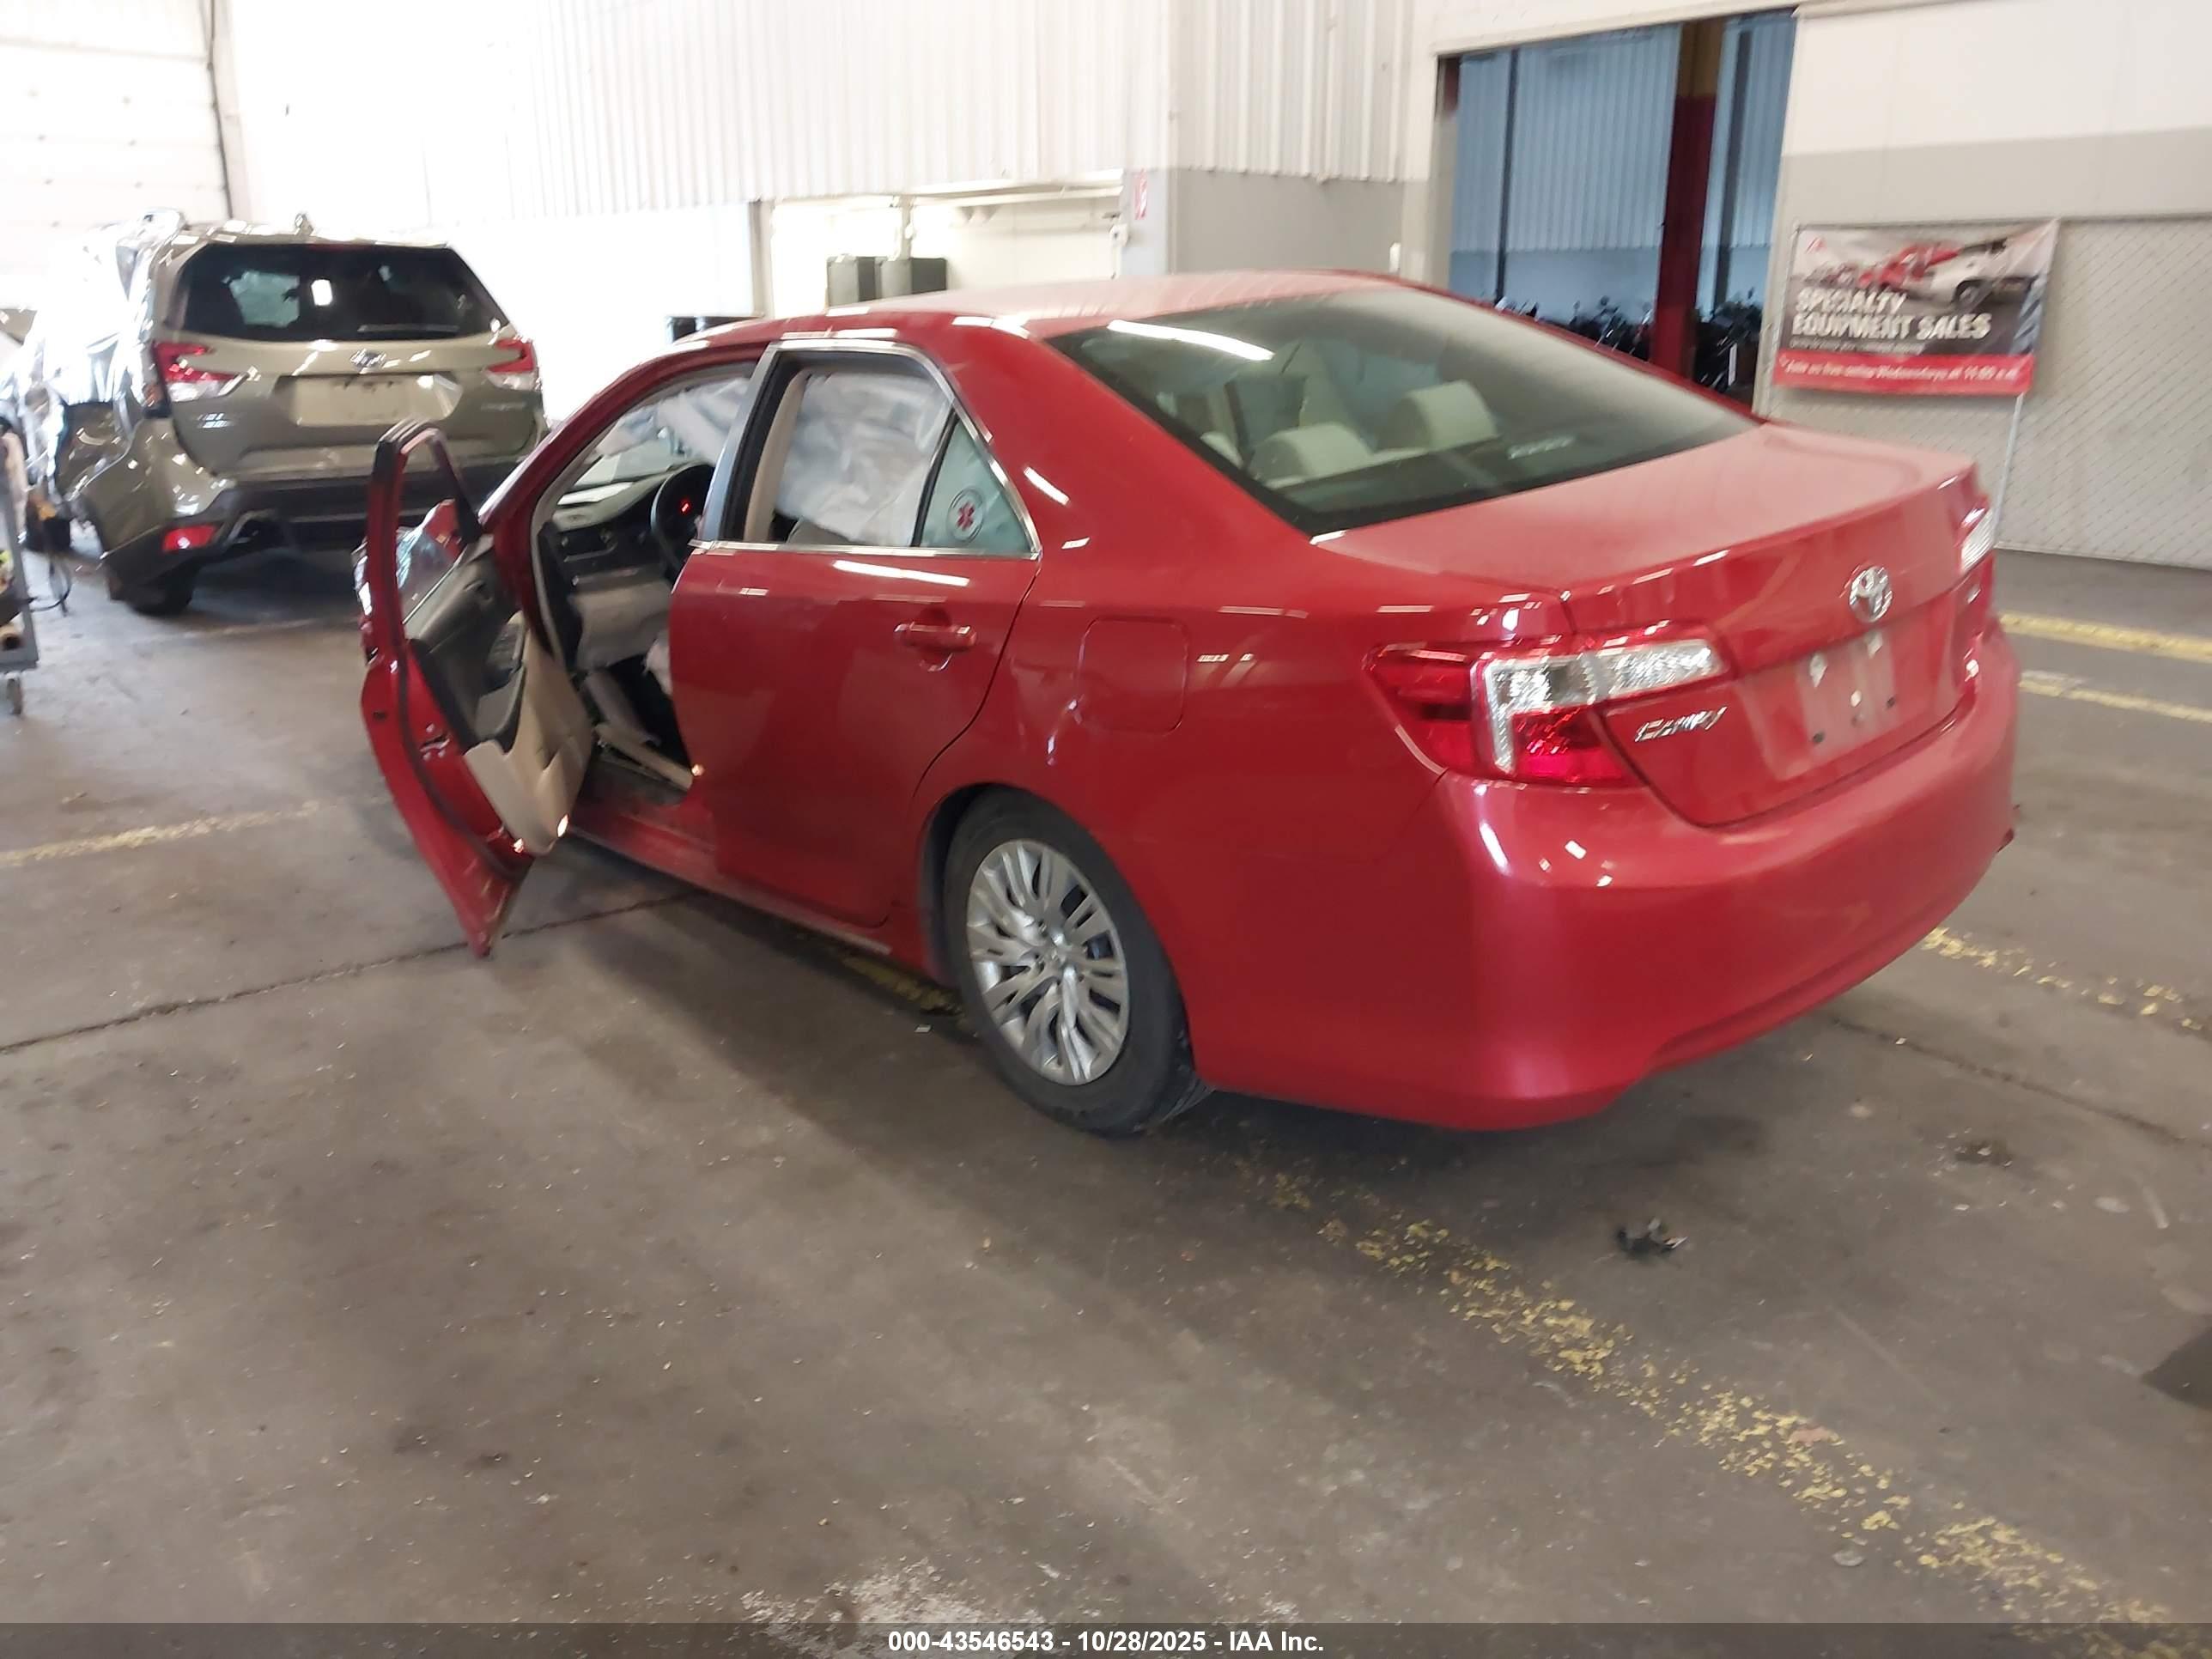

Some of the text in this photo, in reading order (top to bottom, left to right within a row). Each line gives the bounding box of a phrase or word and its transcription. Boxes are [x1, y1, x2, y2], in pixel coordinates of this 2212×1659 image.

[1795, 287, 1908, 313] SPECIALTY
[1792, 311, 1992, 340] EQUIPMENT SALES
